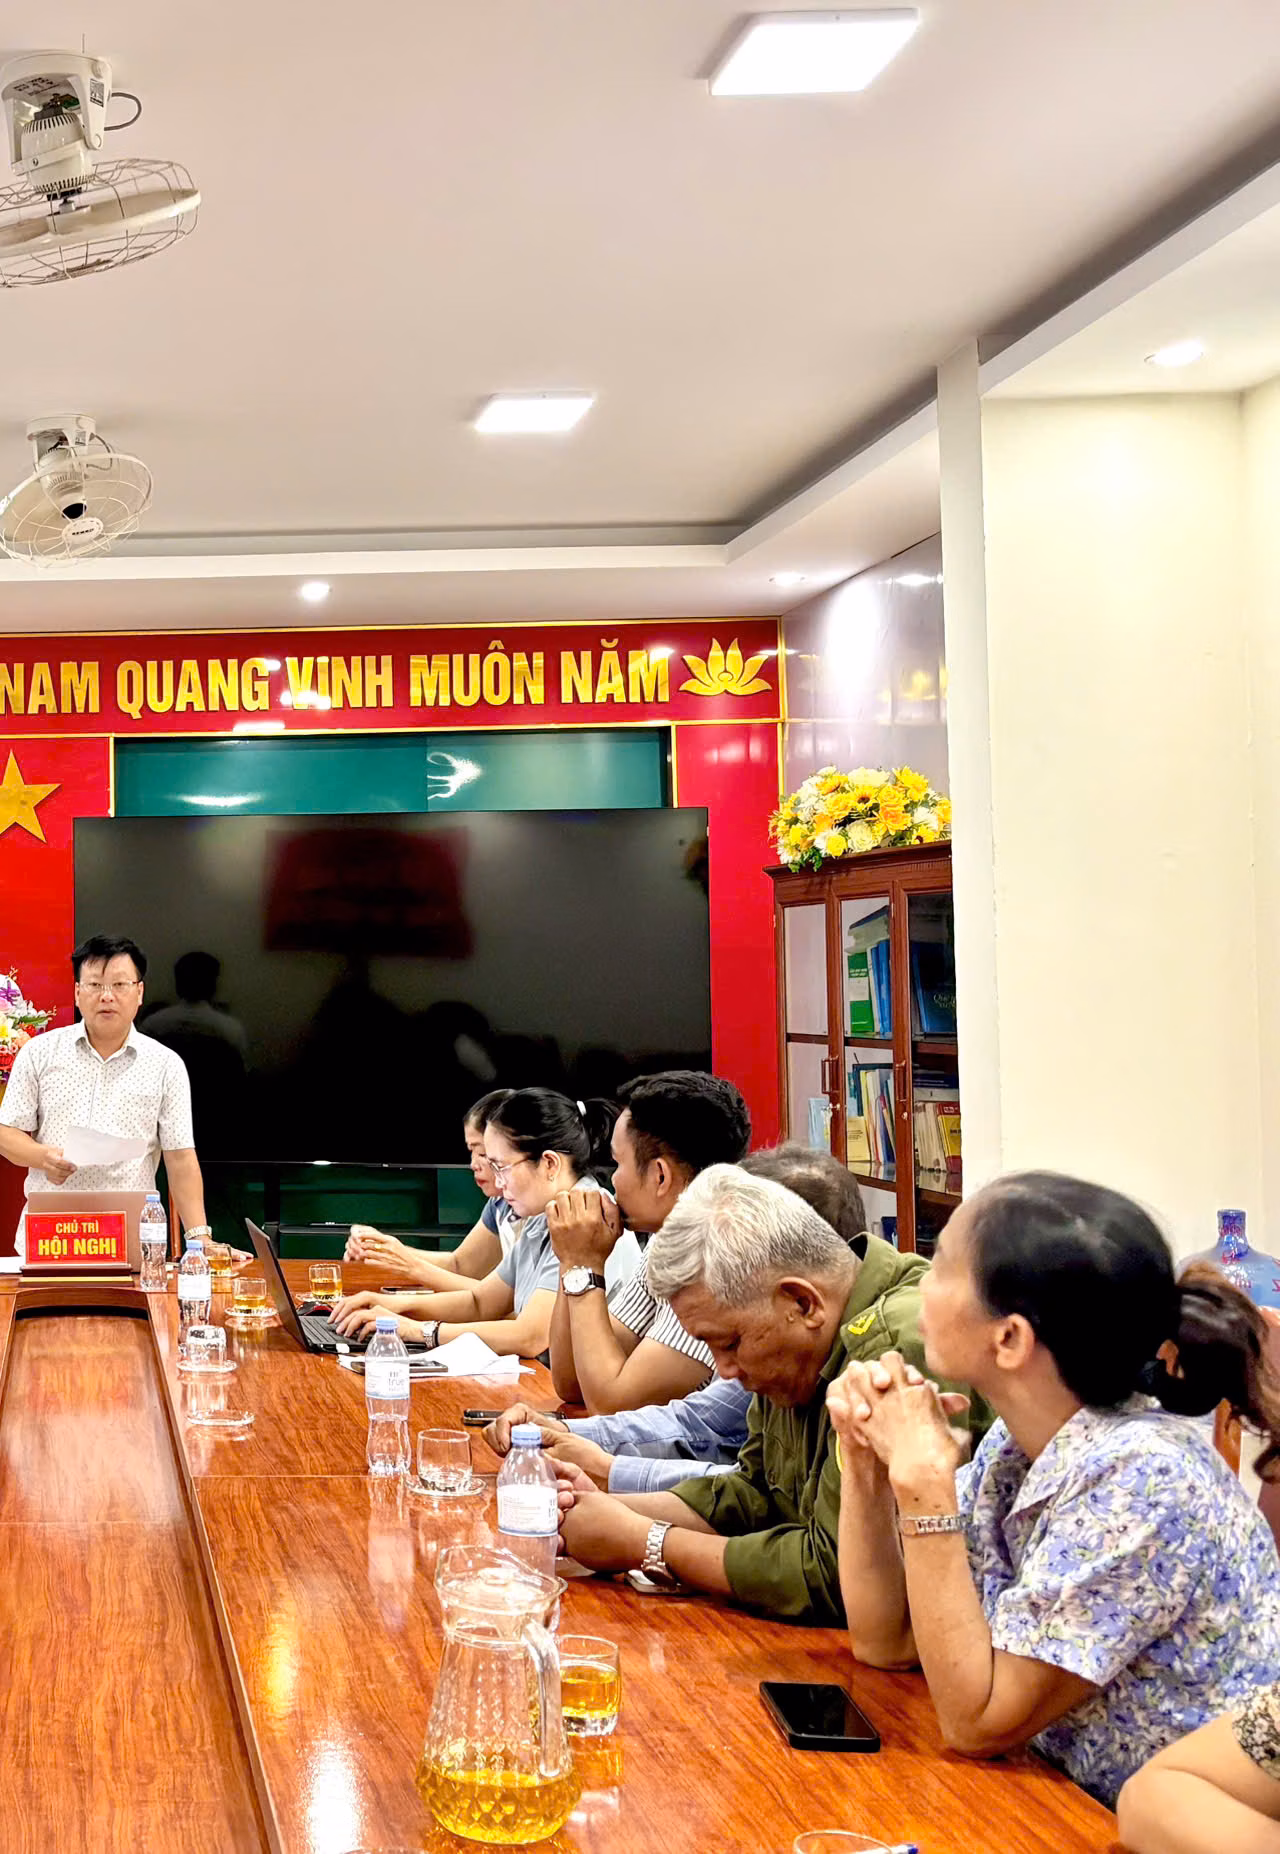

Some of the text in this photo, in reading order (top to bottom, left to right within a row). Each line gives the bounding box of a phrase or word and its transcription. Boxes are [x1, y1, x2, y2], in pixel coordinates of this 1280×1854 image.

[116, 656, 269, 719] QUANG
[285, 655, 393, 711] VINH
[409, 640, 544, 706] MUÔN
[560, 638, 669, 703] NĂM
[55, 1219, 99, 1234] CHỦ TRÌ
[38, 1235, 117, 1259] HỘI NGHỊ
